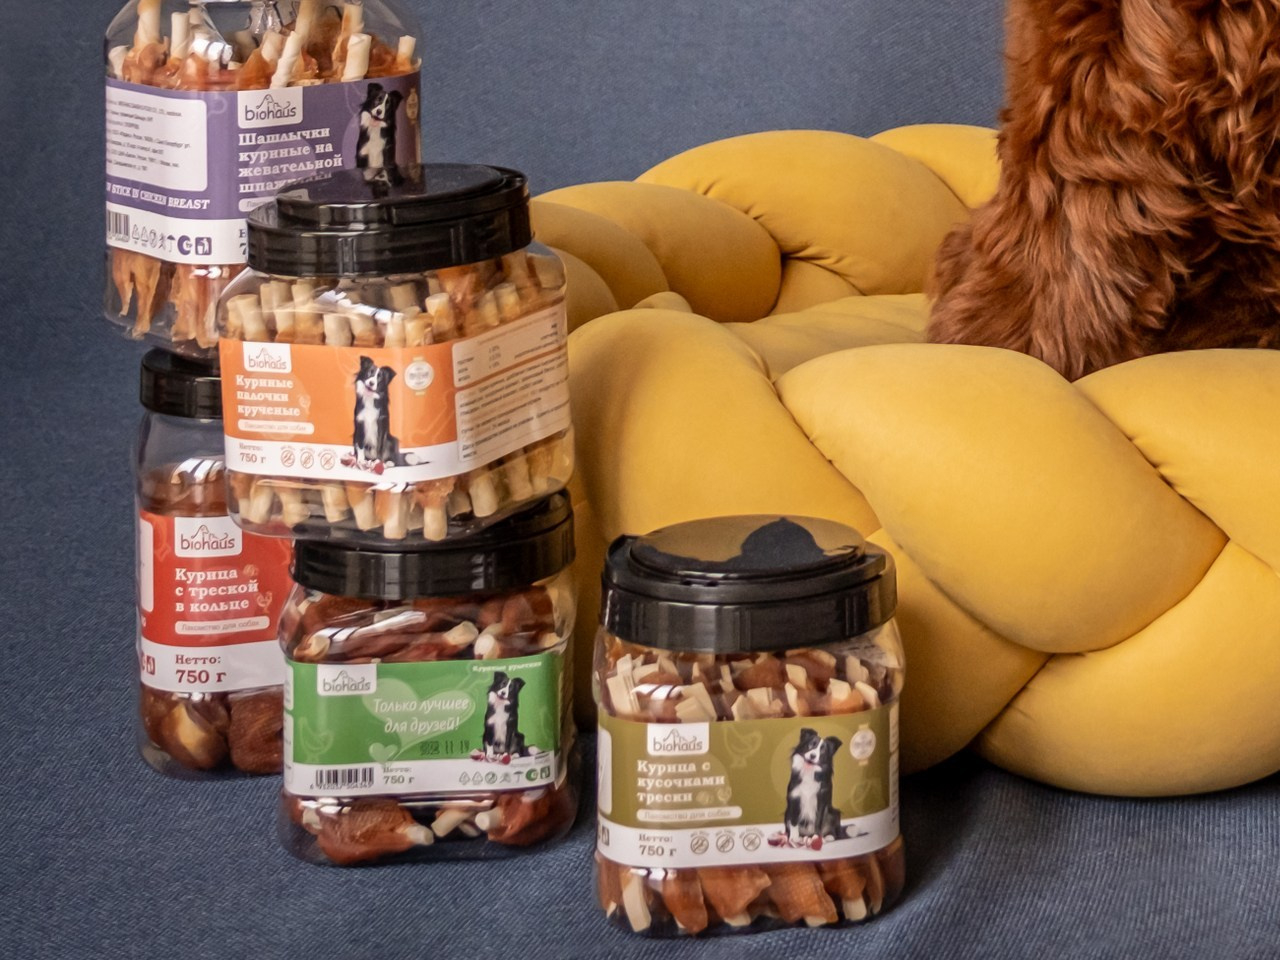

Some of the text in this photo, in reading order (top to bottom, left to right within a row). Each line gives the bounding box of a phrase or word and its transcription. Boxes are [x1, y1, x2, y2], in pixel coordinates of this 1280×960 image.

[245, 104, 297, 121] biohaus
[238, 127, 331, 146] Шашлычки
[238, 142, 334, 164] куриные на
[238, 153, 343, 177] жевательной
[111, 183, 131, 197] STICK
[168, 196, 211, 210] BREAST
[248, 355, 287, 370] biohaus
[235, 374, 294, 389] Куриные
[236, 391, 289, 402] палочки
[237, 405, 301, 417] крученые
[240, 452, 267, 464] 750 г
[180, 533, 235, 551] biohaus
[175, 568, 238, 585] Курица
[175, 579, 259, 600] с треской
[175, 599, 250, 613] в кольце
[175, 654, 221, 665] Нетто:
[175, 669, 227, 684] 750 г
[323, 678, 371, 692] biohaus
[373, 698, 470, 715] Только лучшее
[384, 716, 460, 735] для друзей!
[653, 737, 703, 752] biohaus
[636, 759, 711, 776] Курица с
[383, 775, 405, 784] 750
[637, 775, 725, 790] кусочками
[636, 792, 693, 806] трески
[638, 833, 673, 843] Нетто:
[638, 844, 677, 856] 750 г
